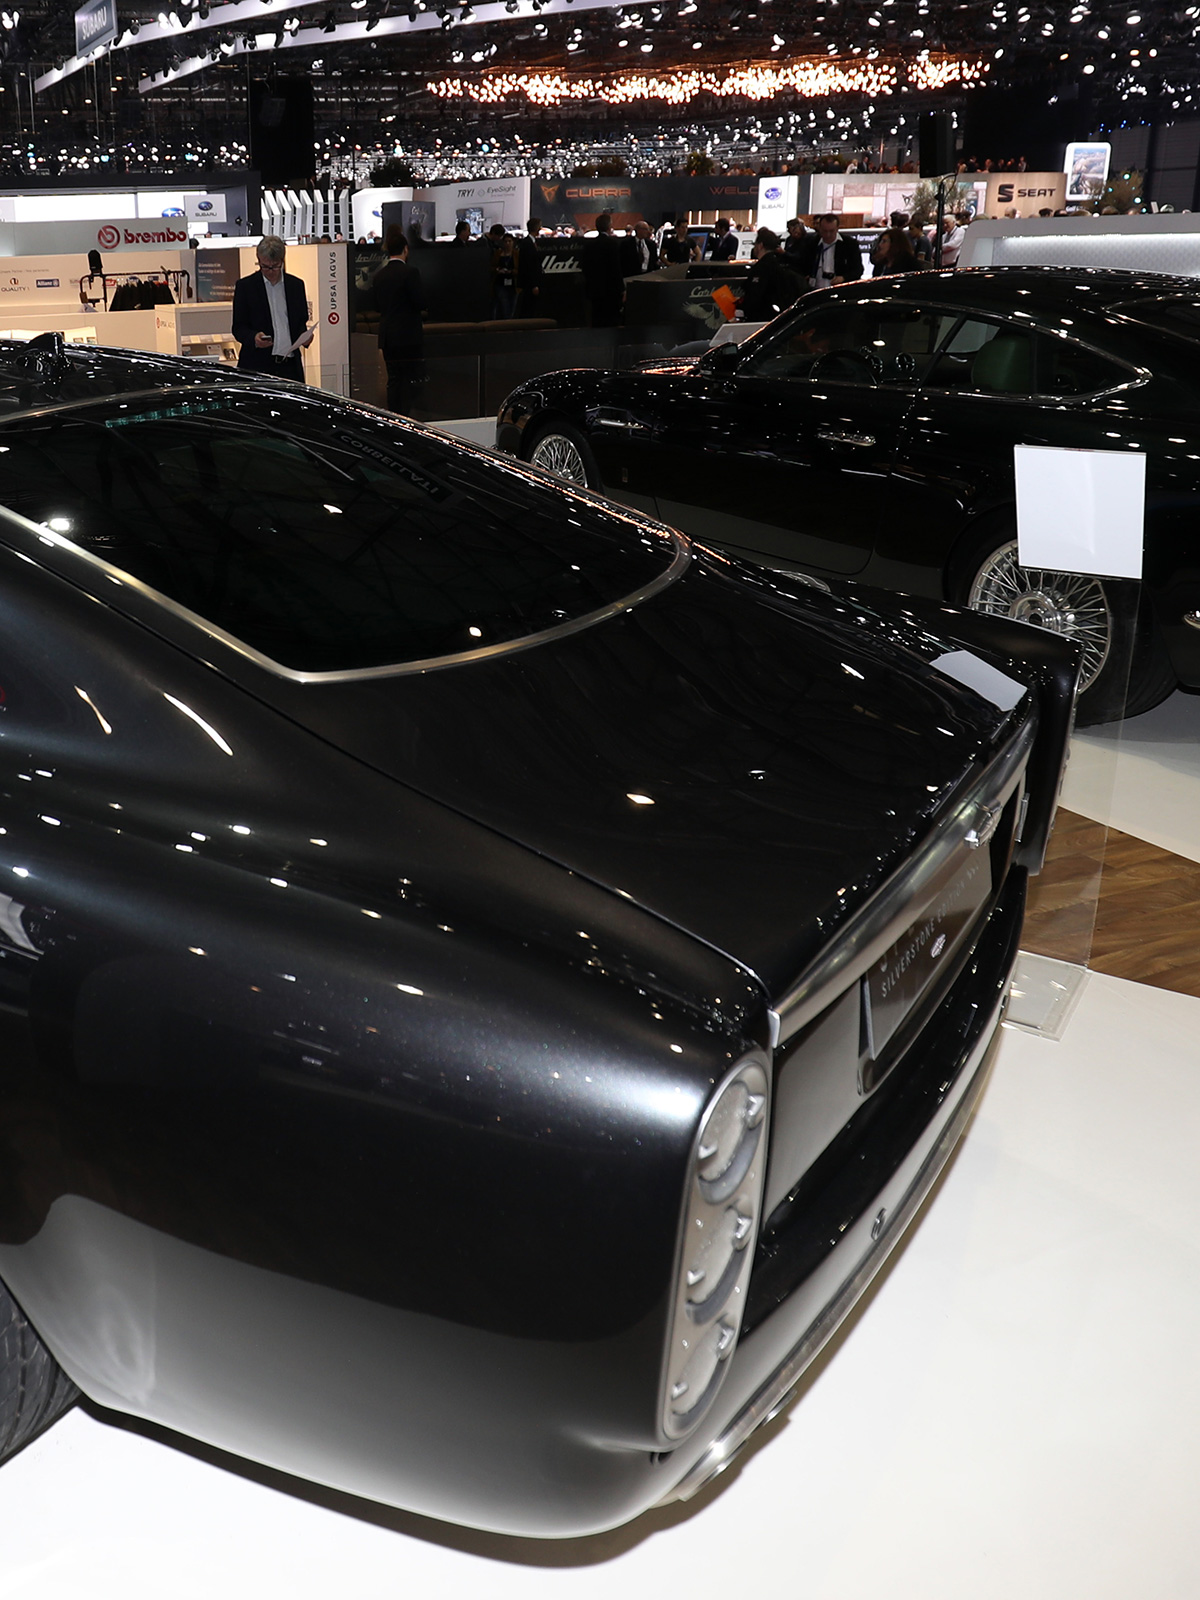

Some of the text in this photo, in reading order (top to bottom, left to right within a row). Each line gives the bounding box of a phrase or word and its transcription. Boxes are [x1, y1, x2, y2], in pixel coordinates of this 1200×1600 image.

[82, 6, 107, 40] SUBARU
[457, 188, 474, 198] TRY!
[565, 188, 631, 198] CUPRA
[709, 186, 758, 195] WELC
[1017, 188, 1056, 198] SEAT
[124, 227, 187, 244] brembo
[328, 251, 337, 278] AGVS
[881, 880, 965, 998] SILVERSTONE EDITION
